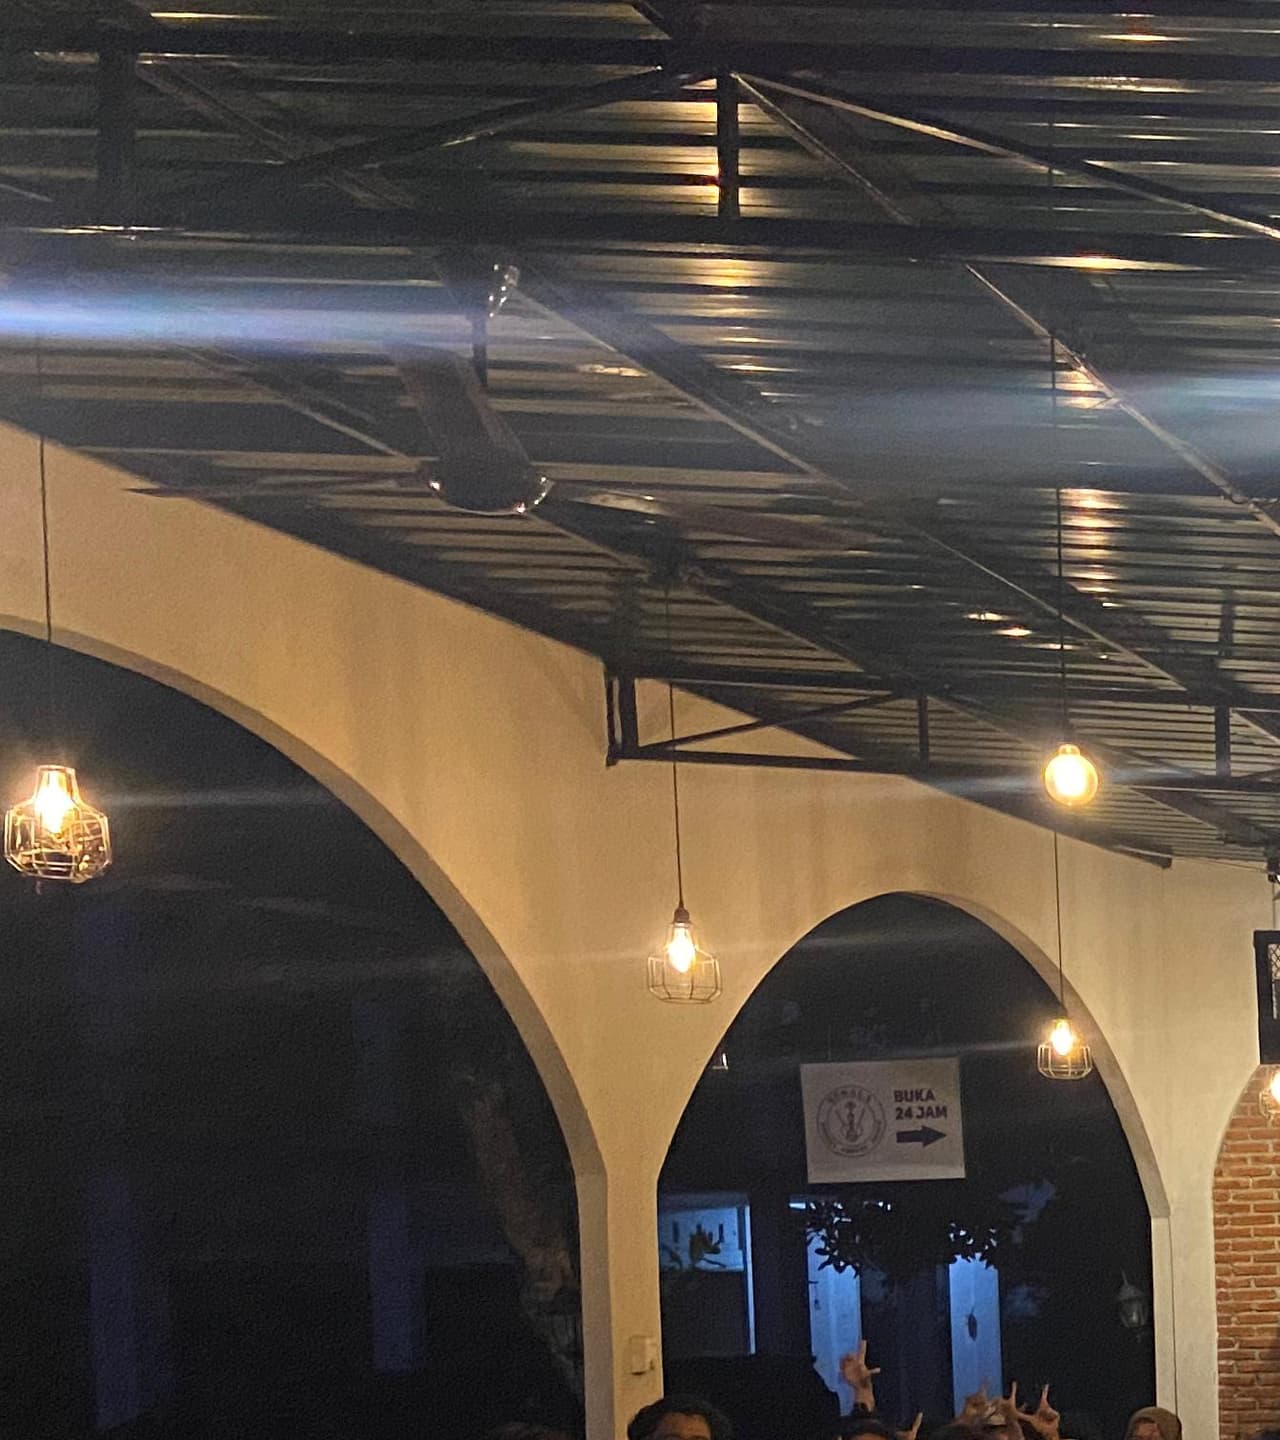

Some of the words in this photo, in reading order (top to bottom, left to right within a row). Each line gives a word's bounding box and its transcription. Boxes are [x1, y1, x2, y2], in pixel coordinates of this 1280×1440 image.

[894, 1089, 936, 1103] BUKA
[895, 1107, 913, 1120] 24
[916, 1106, 948, 1120] JAM
